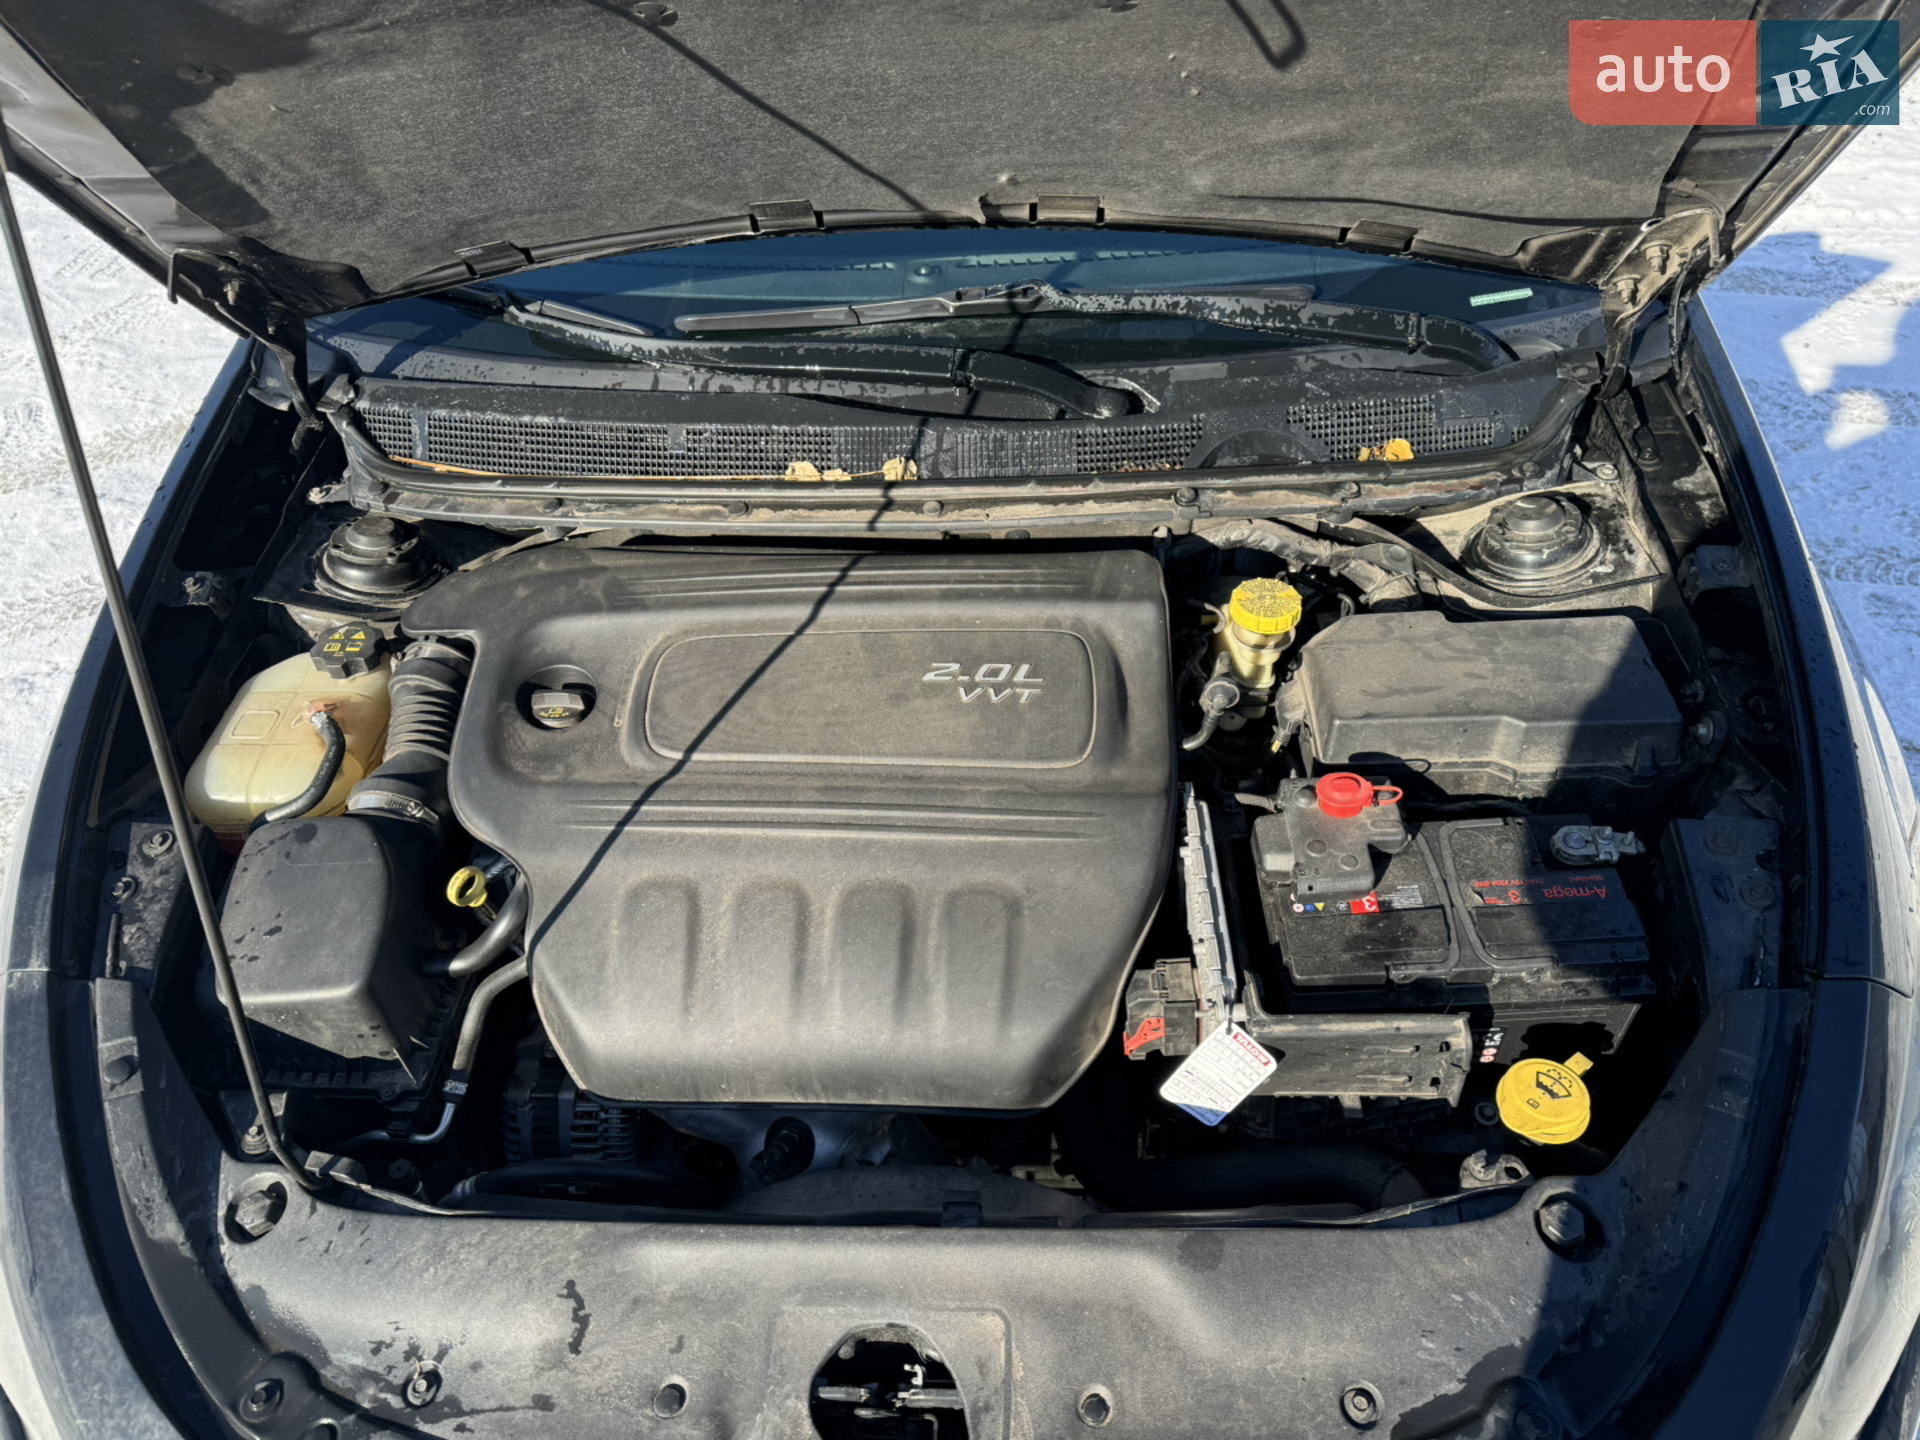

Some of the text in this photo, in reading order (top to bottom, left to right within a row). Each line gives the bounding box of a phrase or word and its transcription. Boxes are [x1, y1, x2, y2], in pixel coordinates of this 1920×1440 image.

[922, 662, 1045, 682] 2.0L
[958, 687, 1043, 703] VVT
[1508, 890, 1523, 904] 3
[1542, 885, 1608, 899] A-mega
[1363, 896, 1377, 911] 3
[1234, 1032, 1270, 1066] MOTUL
